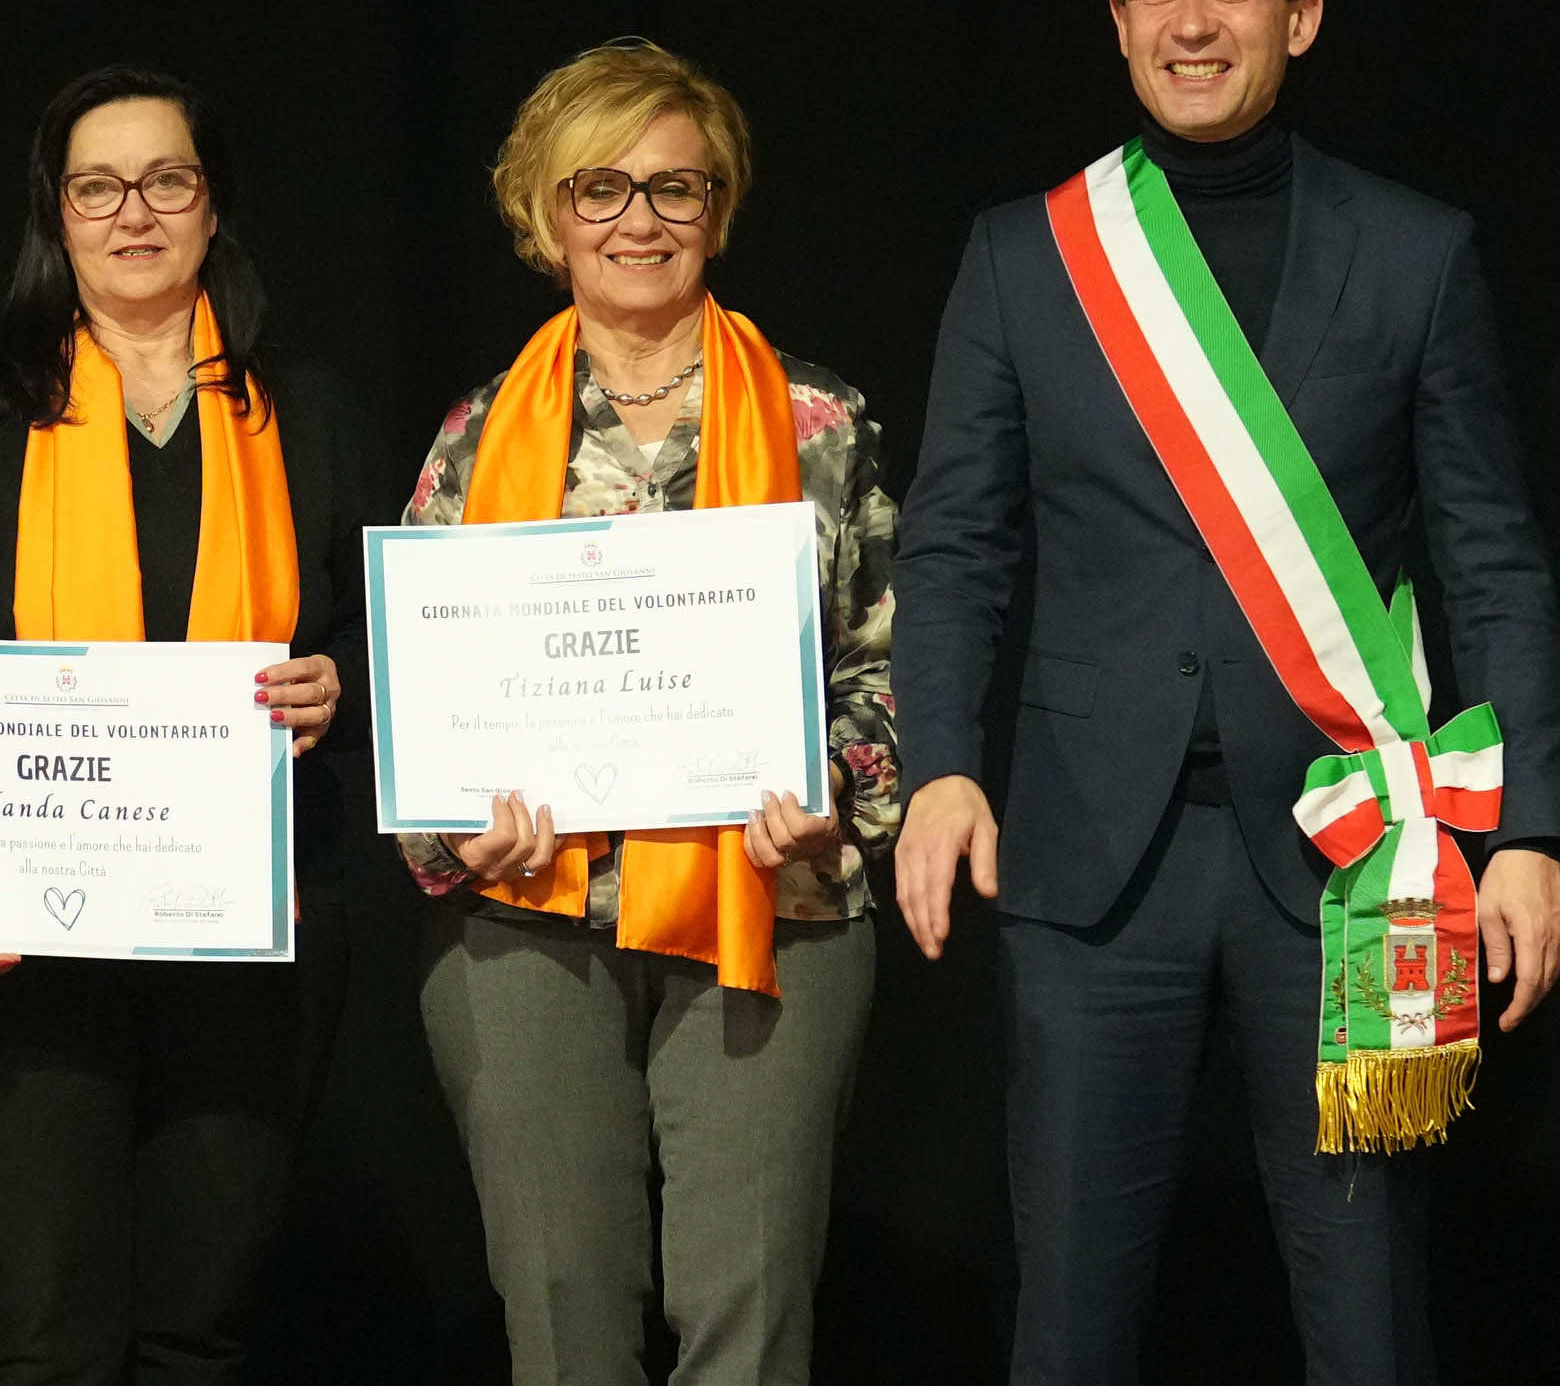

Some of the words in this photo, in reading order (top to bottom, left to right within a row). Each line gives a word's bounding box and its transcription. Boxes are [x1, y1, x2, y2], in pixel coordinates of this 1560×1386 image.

[510, 599, 589, 615] MONDIALE
[598, 597, 626, 611] DEL
[634, 588, 756, 609] VOLONTARIATO
[544, 628, 641, 658] GRAZIE
[500, 672, 606, 697] Tiziana
[621, 669, 692, 691] Luise
[71, 724, 99, 737] DEL
[107, 725, 230, 738] VOLONTARIATO
[17, 754, 112, 781] GRAZIE
[80, 799, 170, 820] Canese
[10, 838, 56, 852] passione
[69, 833, 109, 851] l'amore
[113, 834, 132, 851] che
[136, 836, 152, 852] hai
[155, 836, 202, 853] dedicato
[18, 858, 38, 874] alla
[42, 865, 76, 875] nostra
[79, 860, 107, 877] Città
